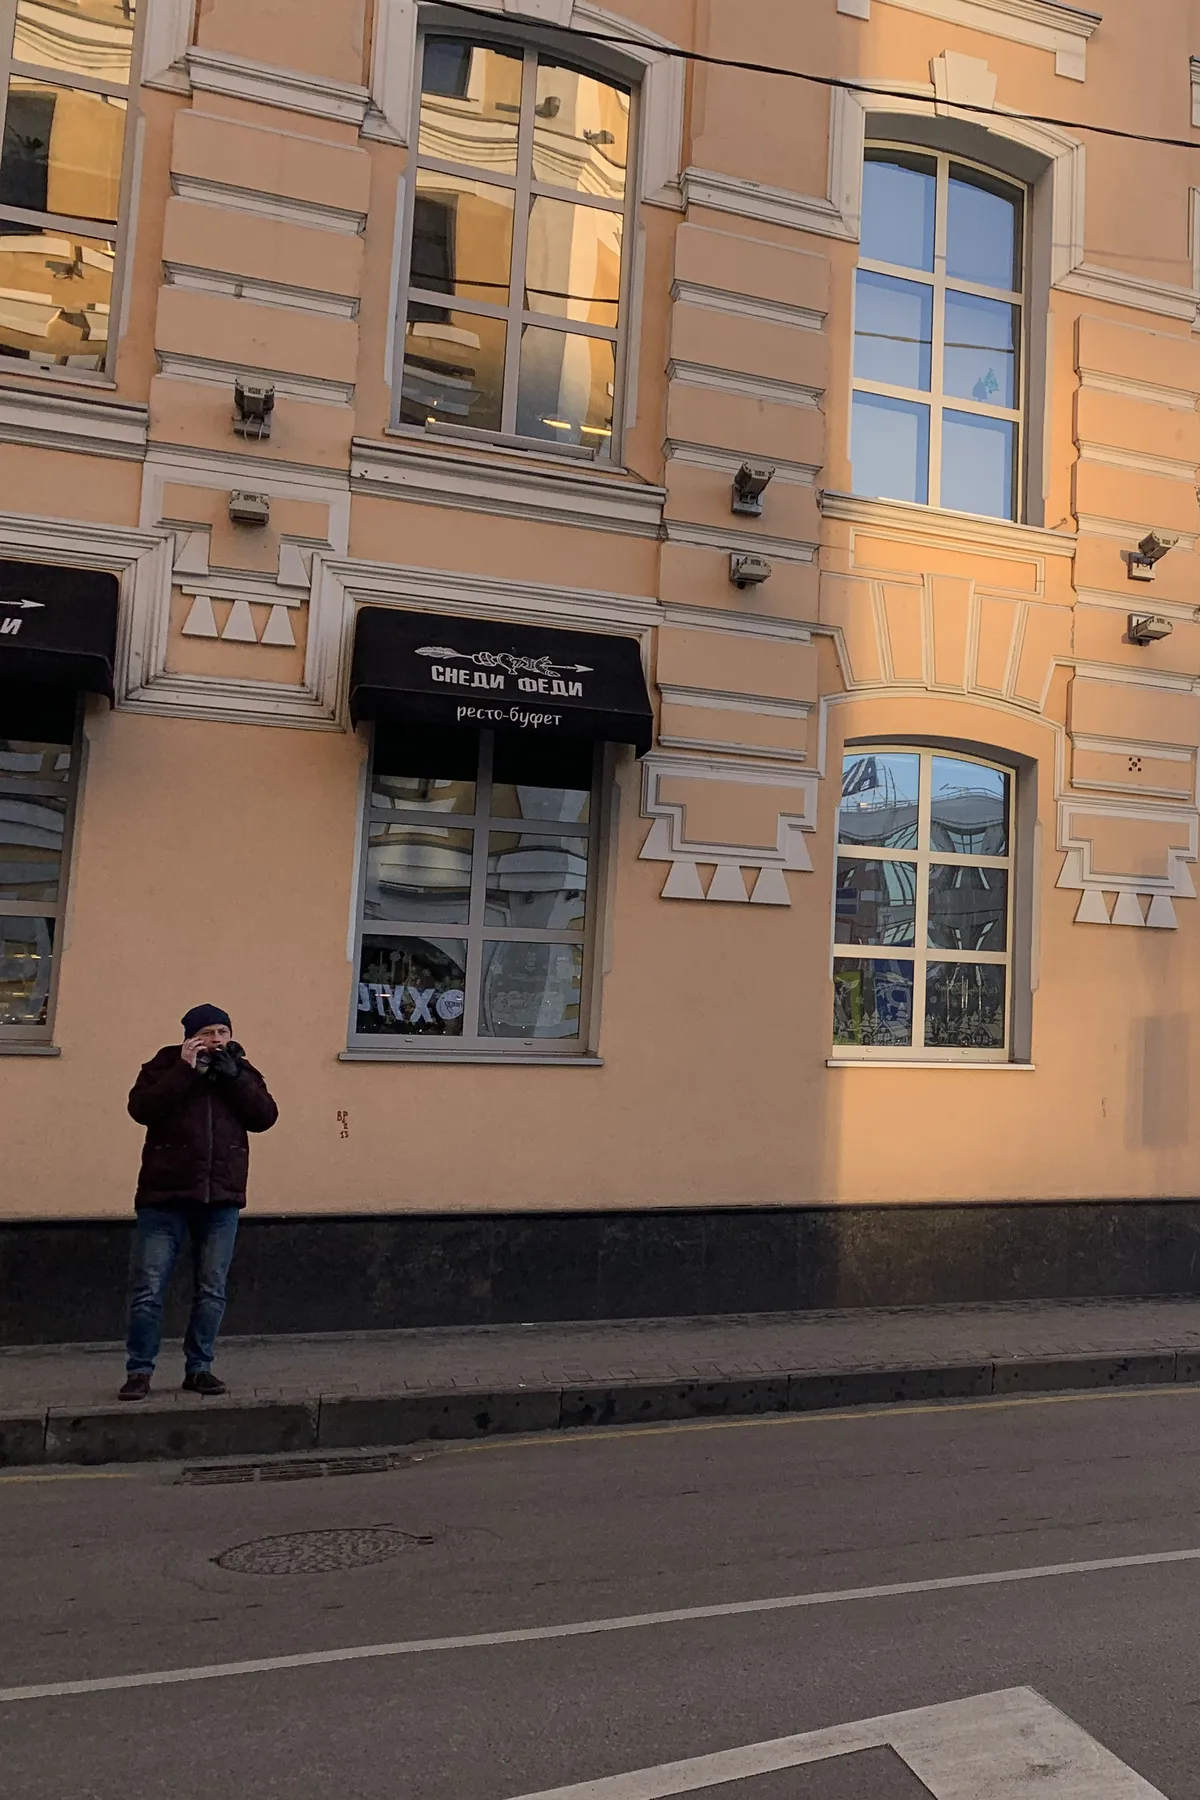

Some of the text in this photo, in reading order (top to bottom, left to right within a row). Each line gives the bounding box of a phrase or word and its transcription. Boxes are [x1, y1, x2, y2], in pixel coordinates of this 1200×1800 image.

[431, 665, 583, 697] СНЕДИ ФЕДИ
[456, 705, 562, 728] ресто-буфет
